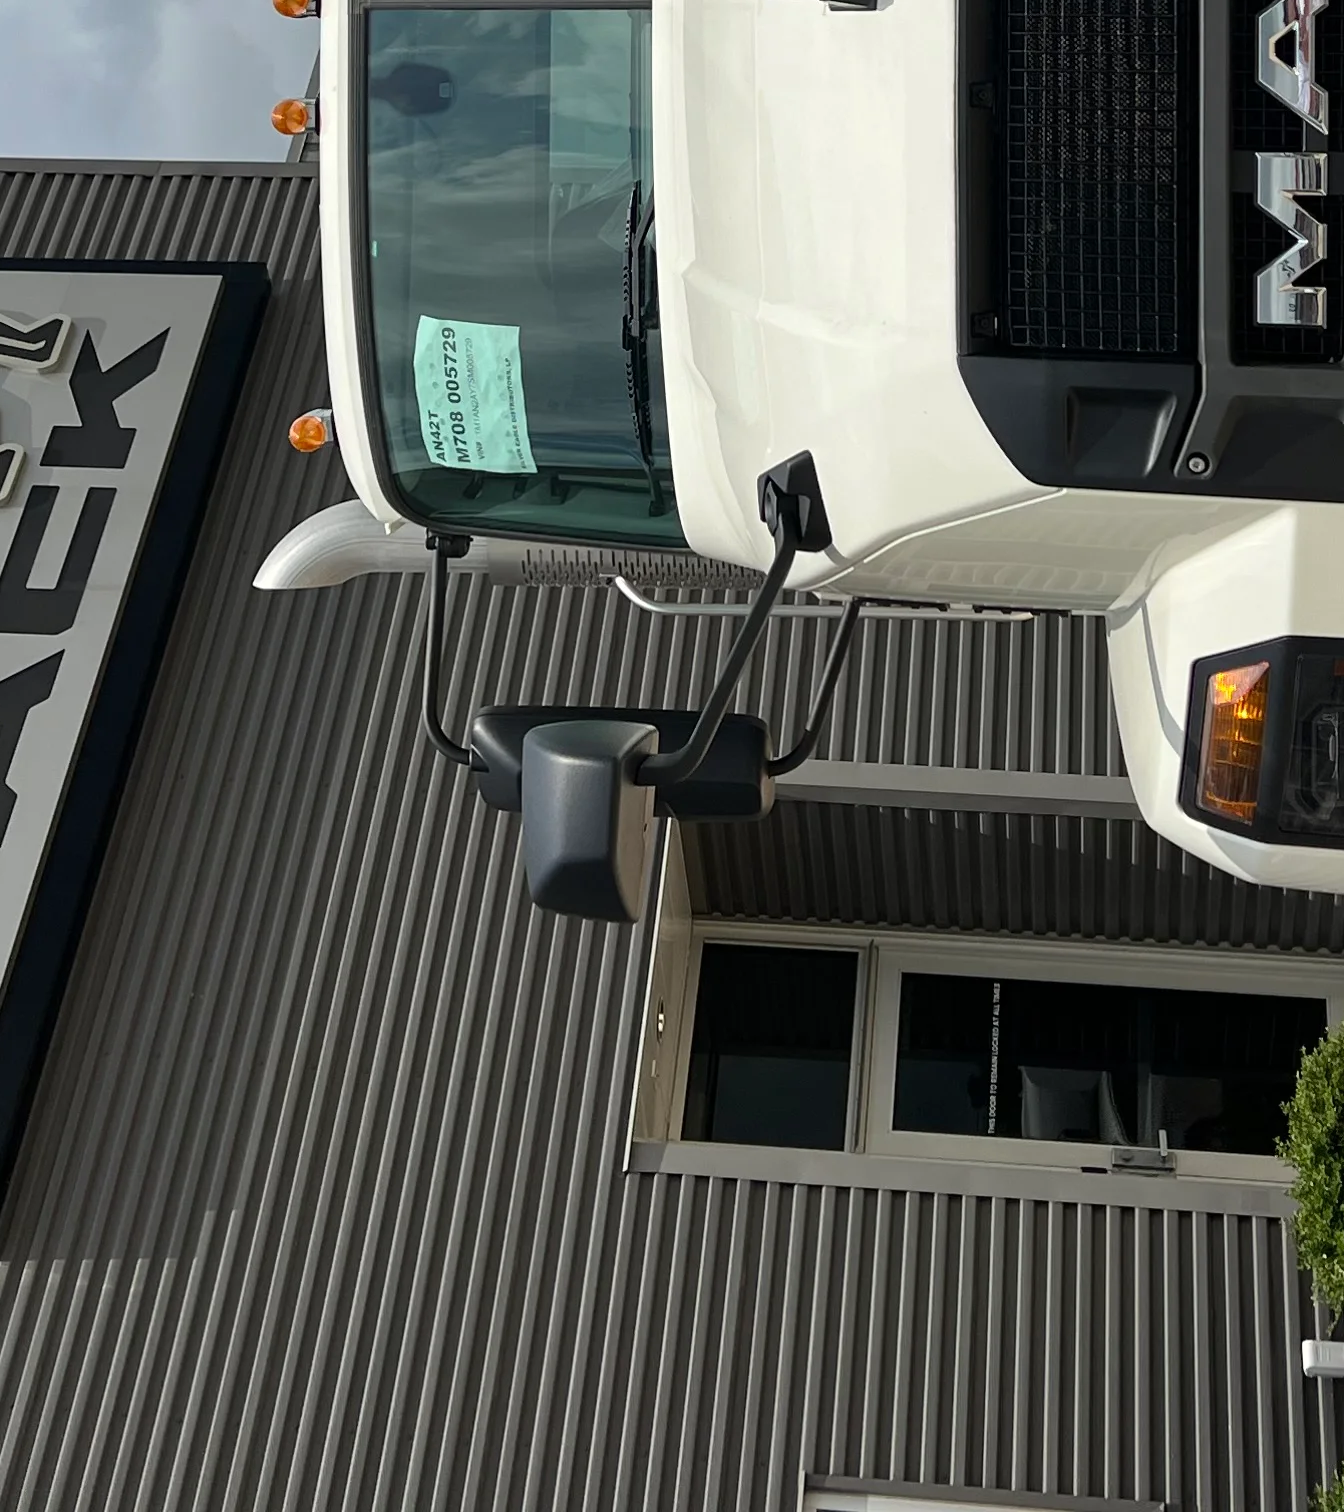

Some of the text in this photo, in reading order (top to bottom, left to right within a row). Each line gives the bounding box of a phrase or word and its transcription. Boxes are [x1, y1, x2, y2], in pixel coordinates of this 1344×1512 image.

[441, 326, 471, 463] M708 005729
[428, 409, 447, 462] AN42T
[993, 1015, 999, 1026] AT
[990, 1083, 997, 1094] TO
